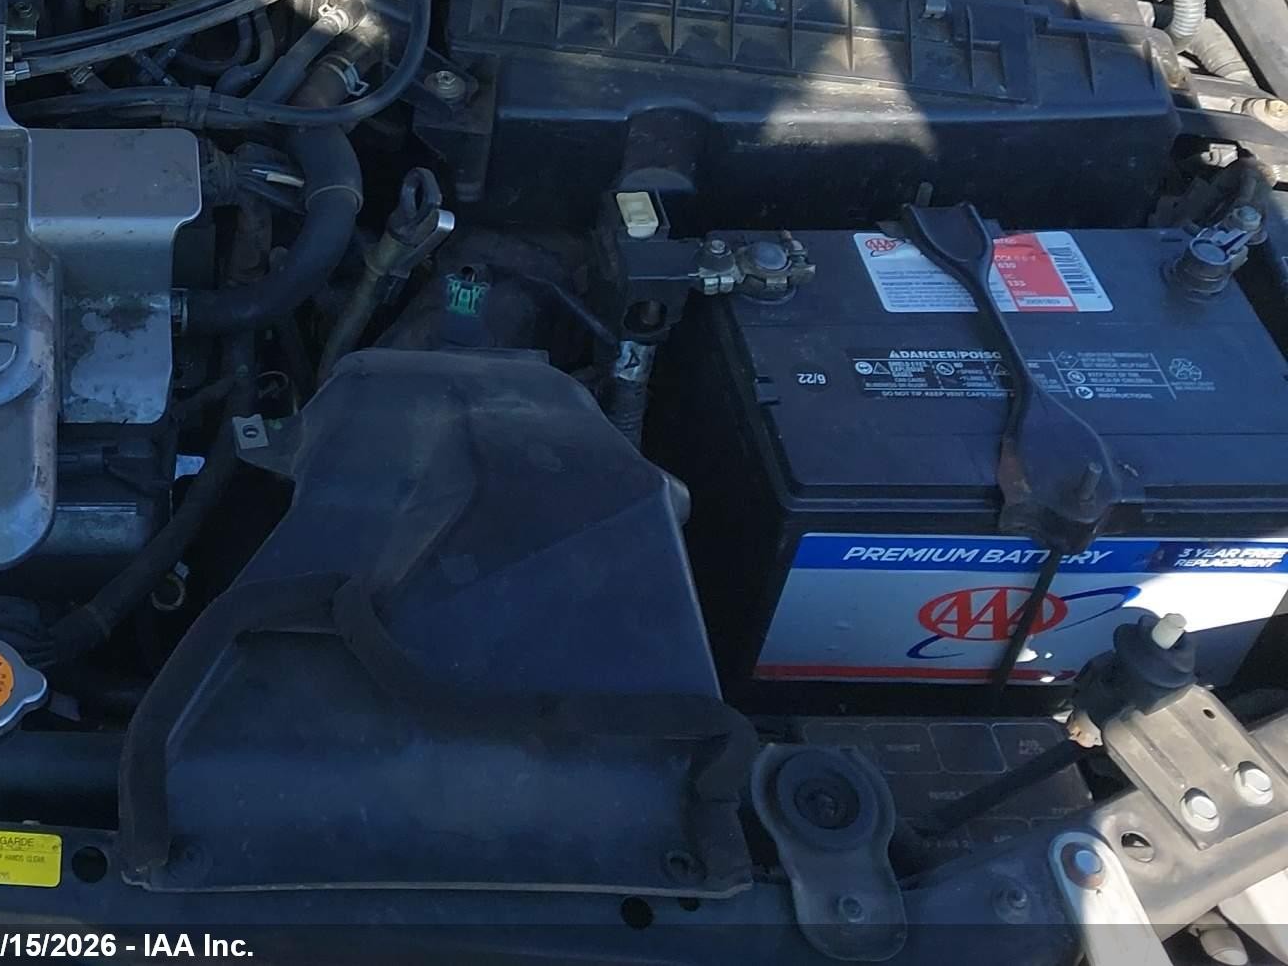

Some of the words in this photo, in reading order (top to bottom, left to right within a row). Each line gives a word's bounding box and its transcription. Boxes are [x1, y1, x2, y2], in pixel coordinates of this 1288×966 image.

[899, 350, 1002, 359] DANGER/POISO
[842, 546, 981, 563] PREMIUM
[1177, 548, 1194, 558] 3
[1173, 558, 1283, 568] REPLACEMENT
[0, 837, 34, 847] GARDE
